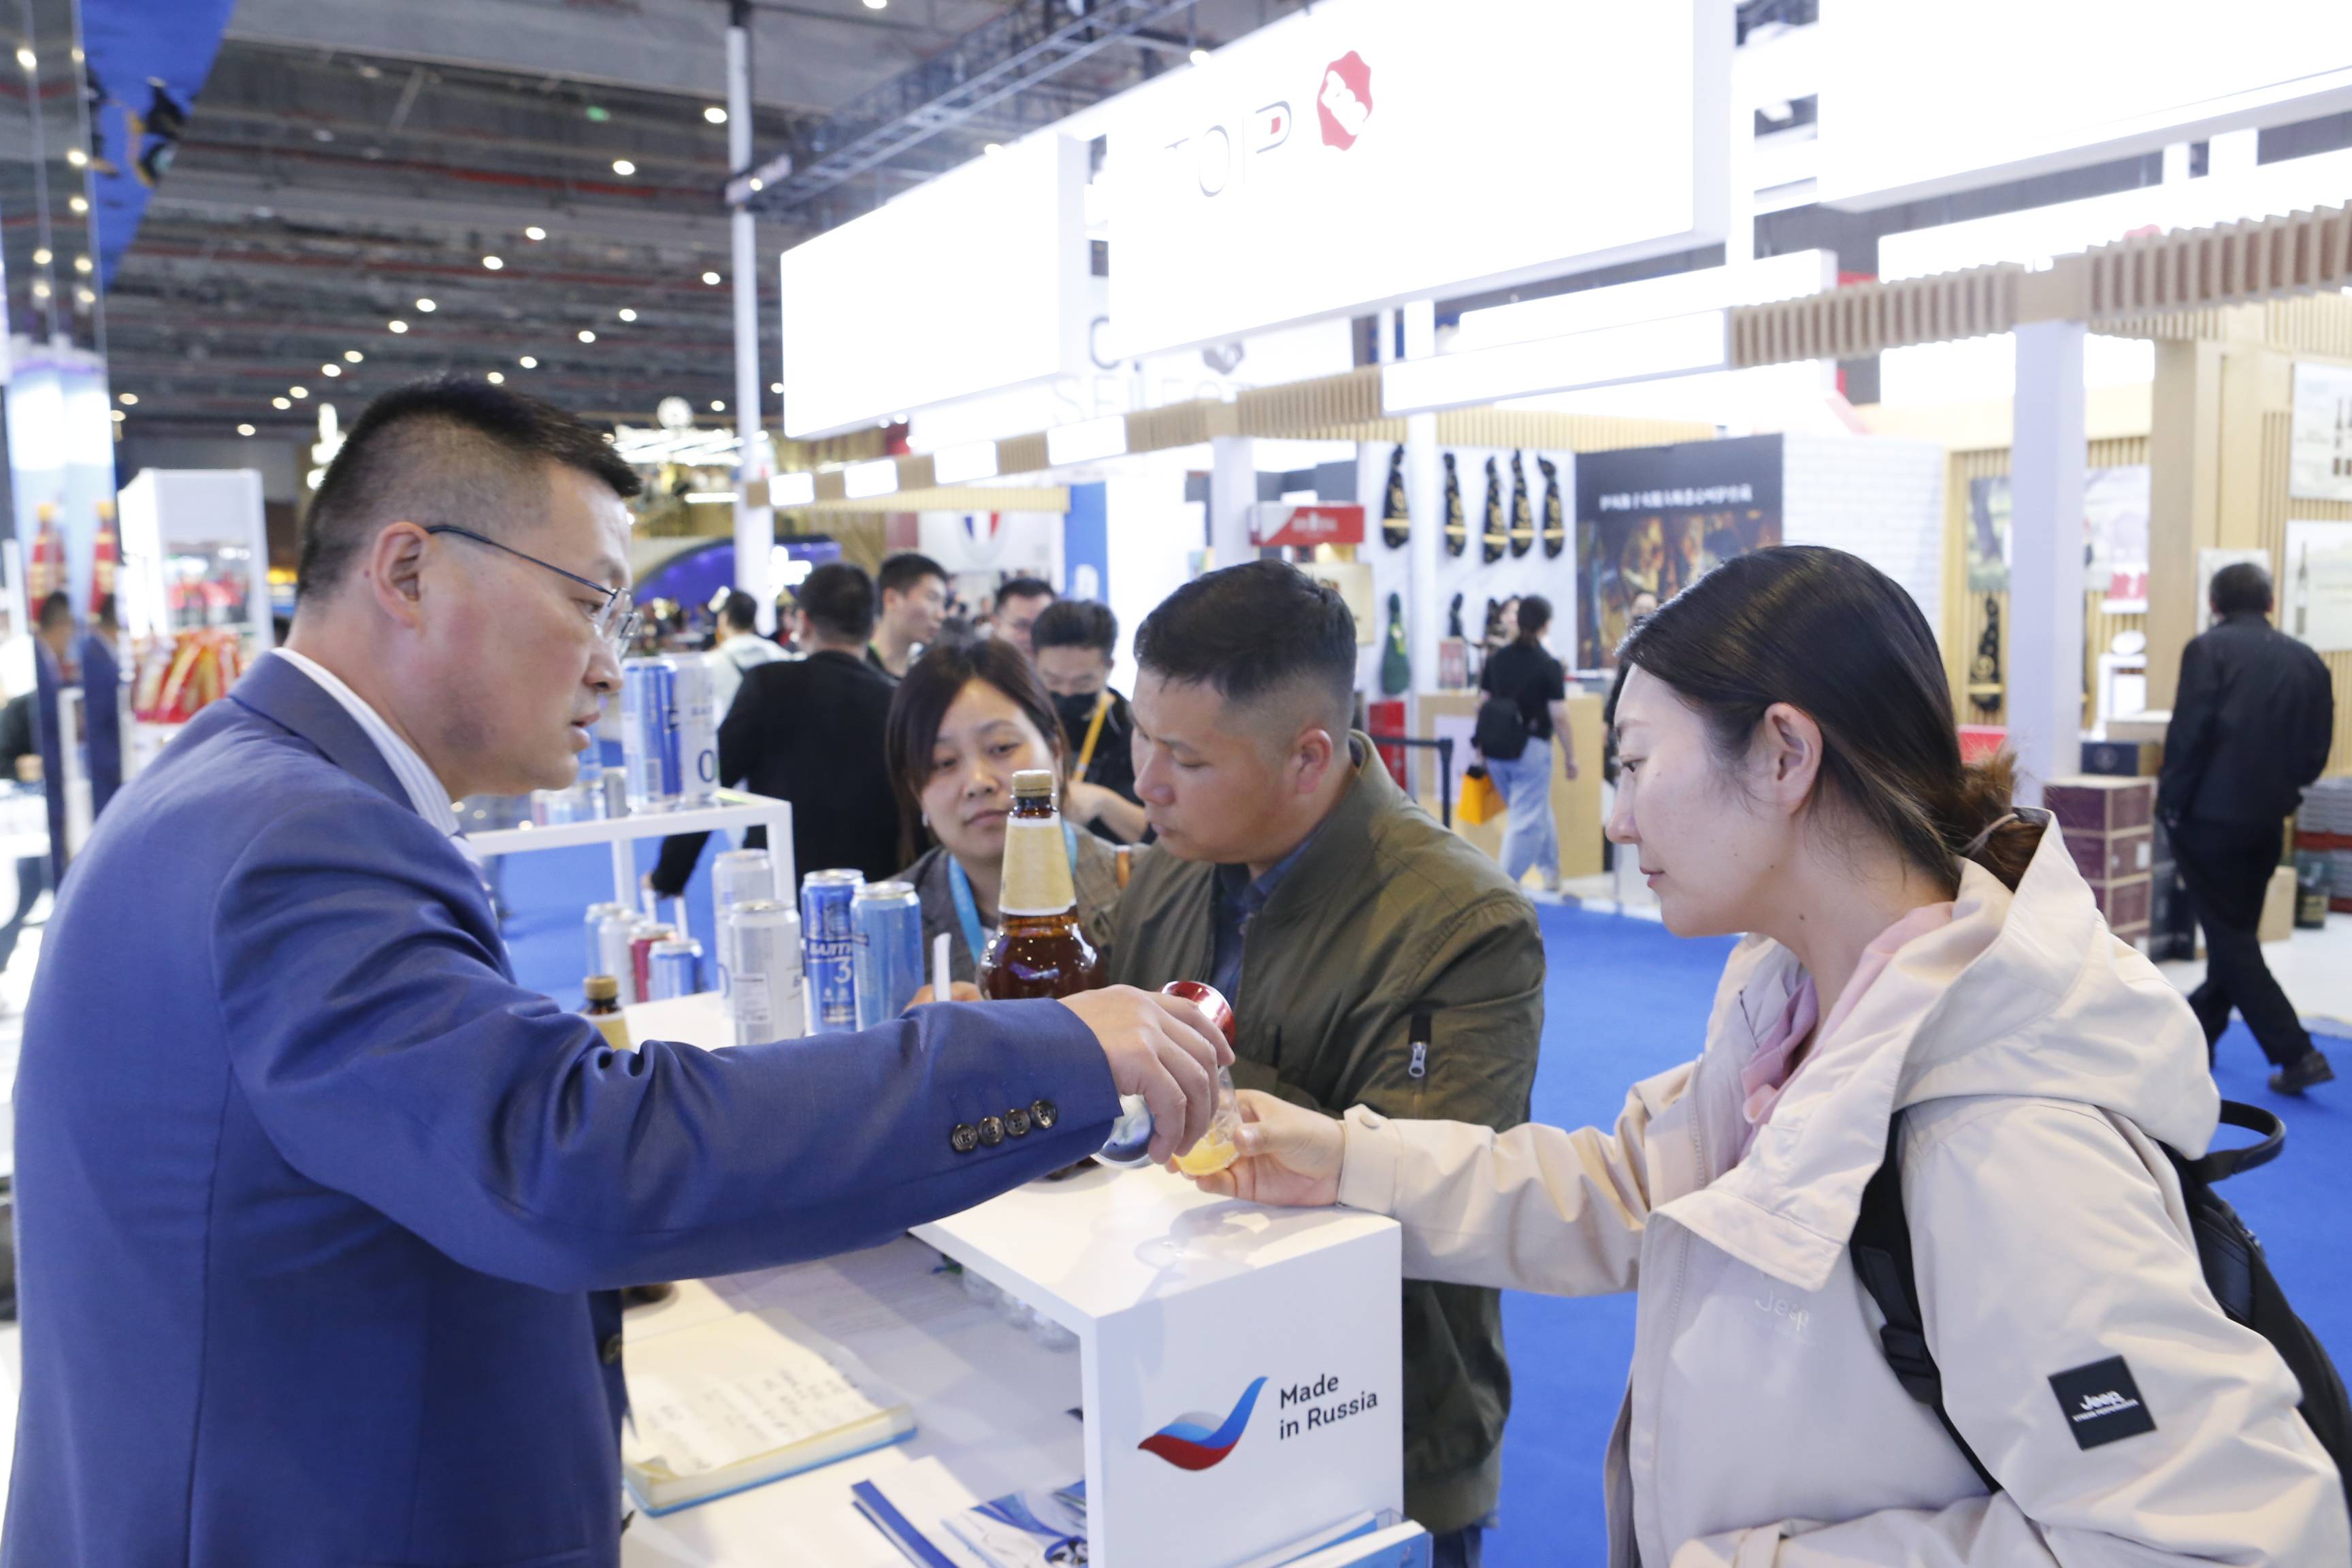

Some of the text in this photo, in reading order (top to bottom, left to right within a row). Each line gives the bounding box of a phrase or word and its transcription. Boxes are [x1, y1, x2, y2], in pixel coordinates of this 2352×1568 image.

[834, 957, 852, 984] 3
[1280, 1373, 1339, 1409] Made
[1280, 1391, 1377, 1440] in Russia
